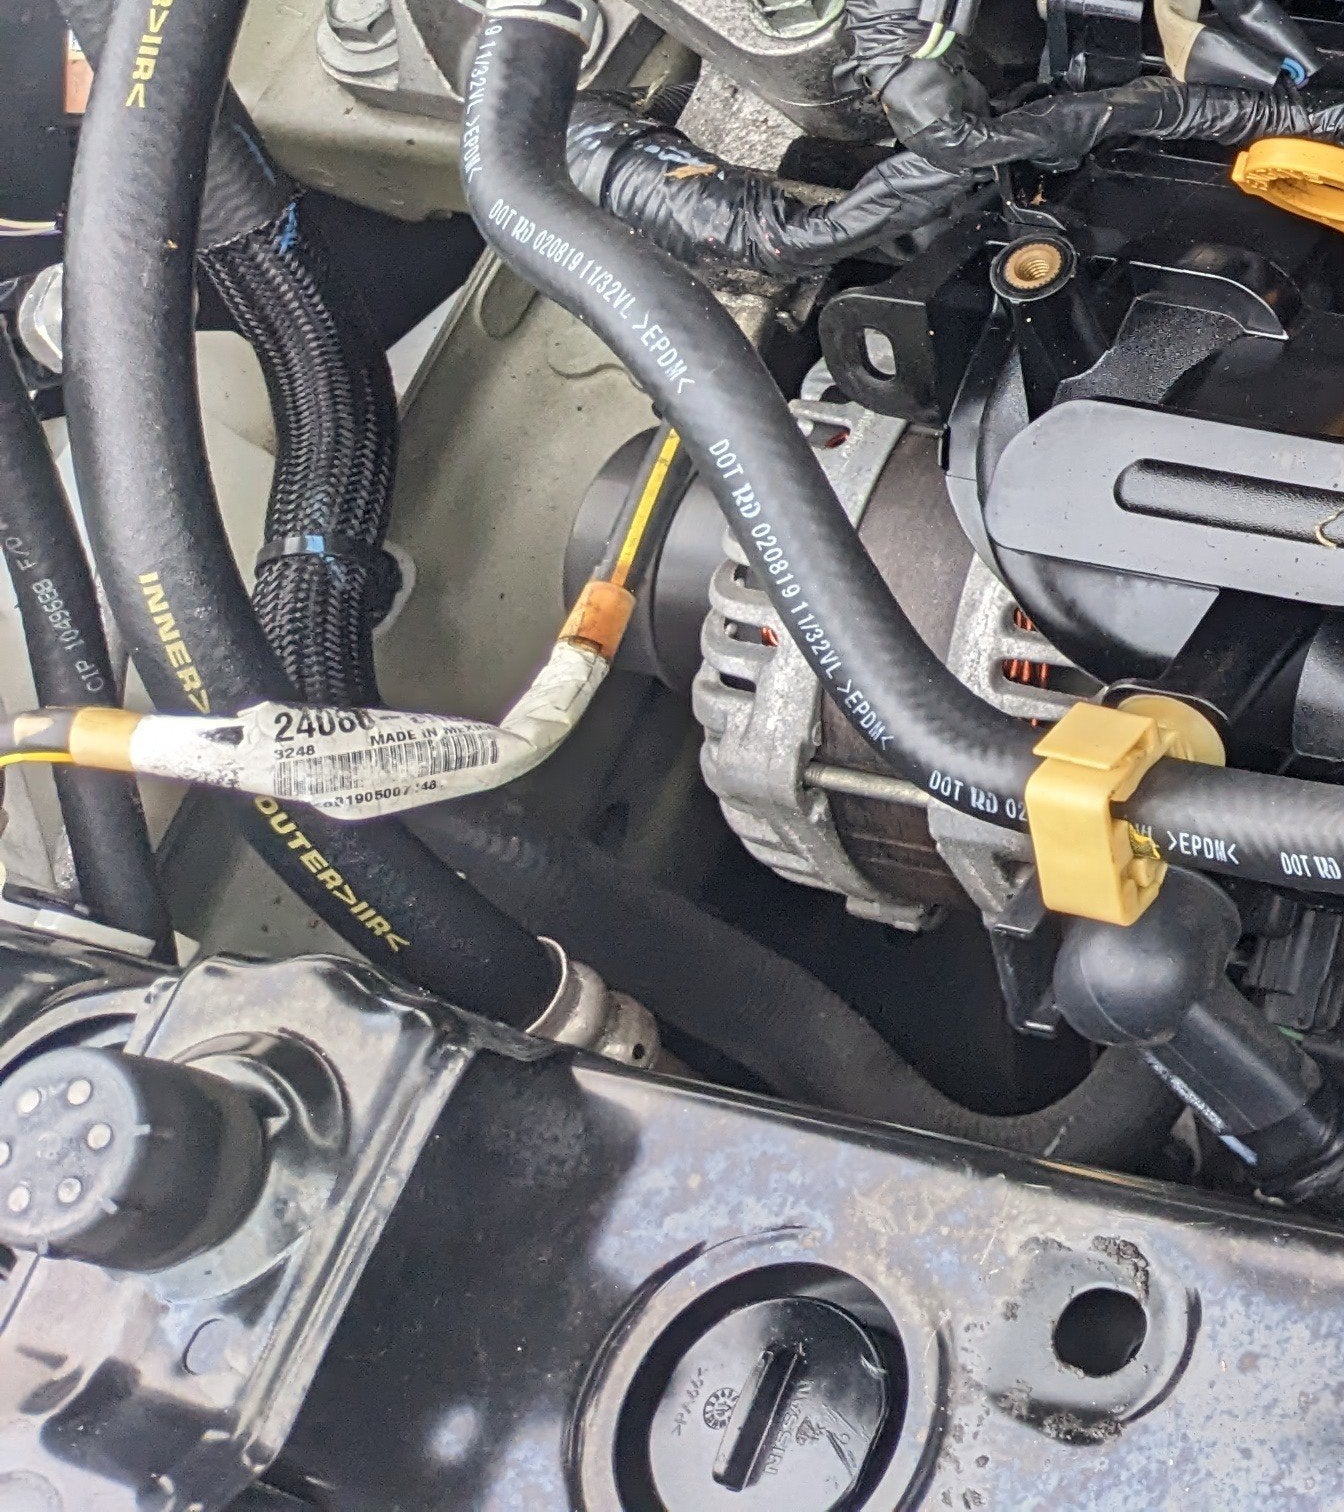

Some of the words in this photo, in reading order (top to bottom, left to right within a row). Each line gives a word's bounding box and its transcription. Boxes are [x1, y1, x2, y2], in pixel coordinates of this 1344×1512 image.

[709, 438, 744, 480] DOT
[751, 523, 801, 599] 020819
[369, 729, 418, 748] MADE
[928, 769, 965, 801] DOT
[1280, 851, 1311, 879] DOT
